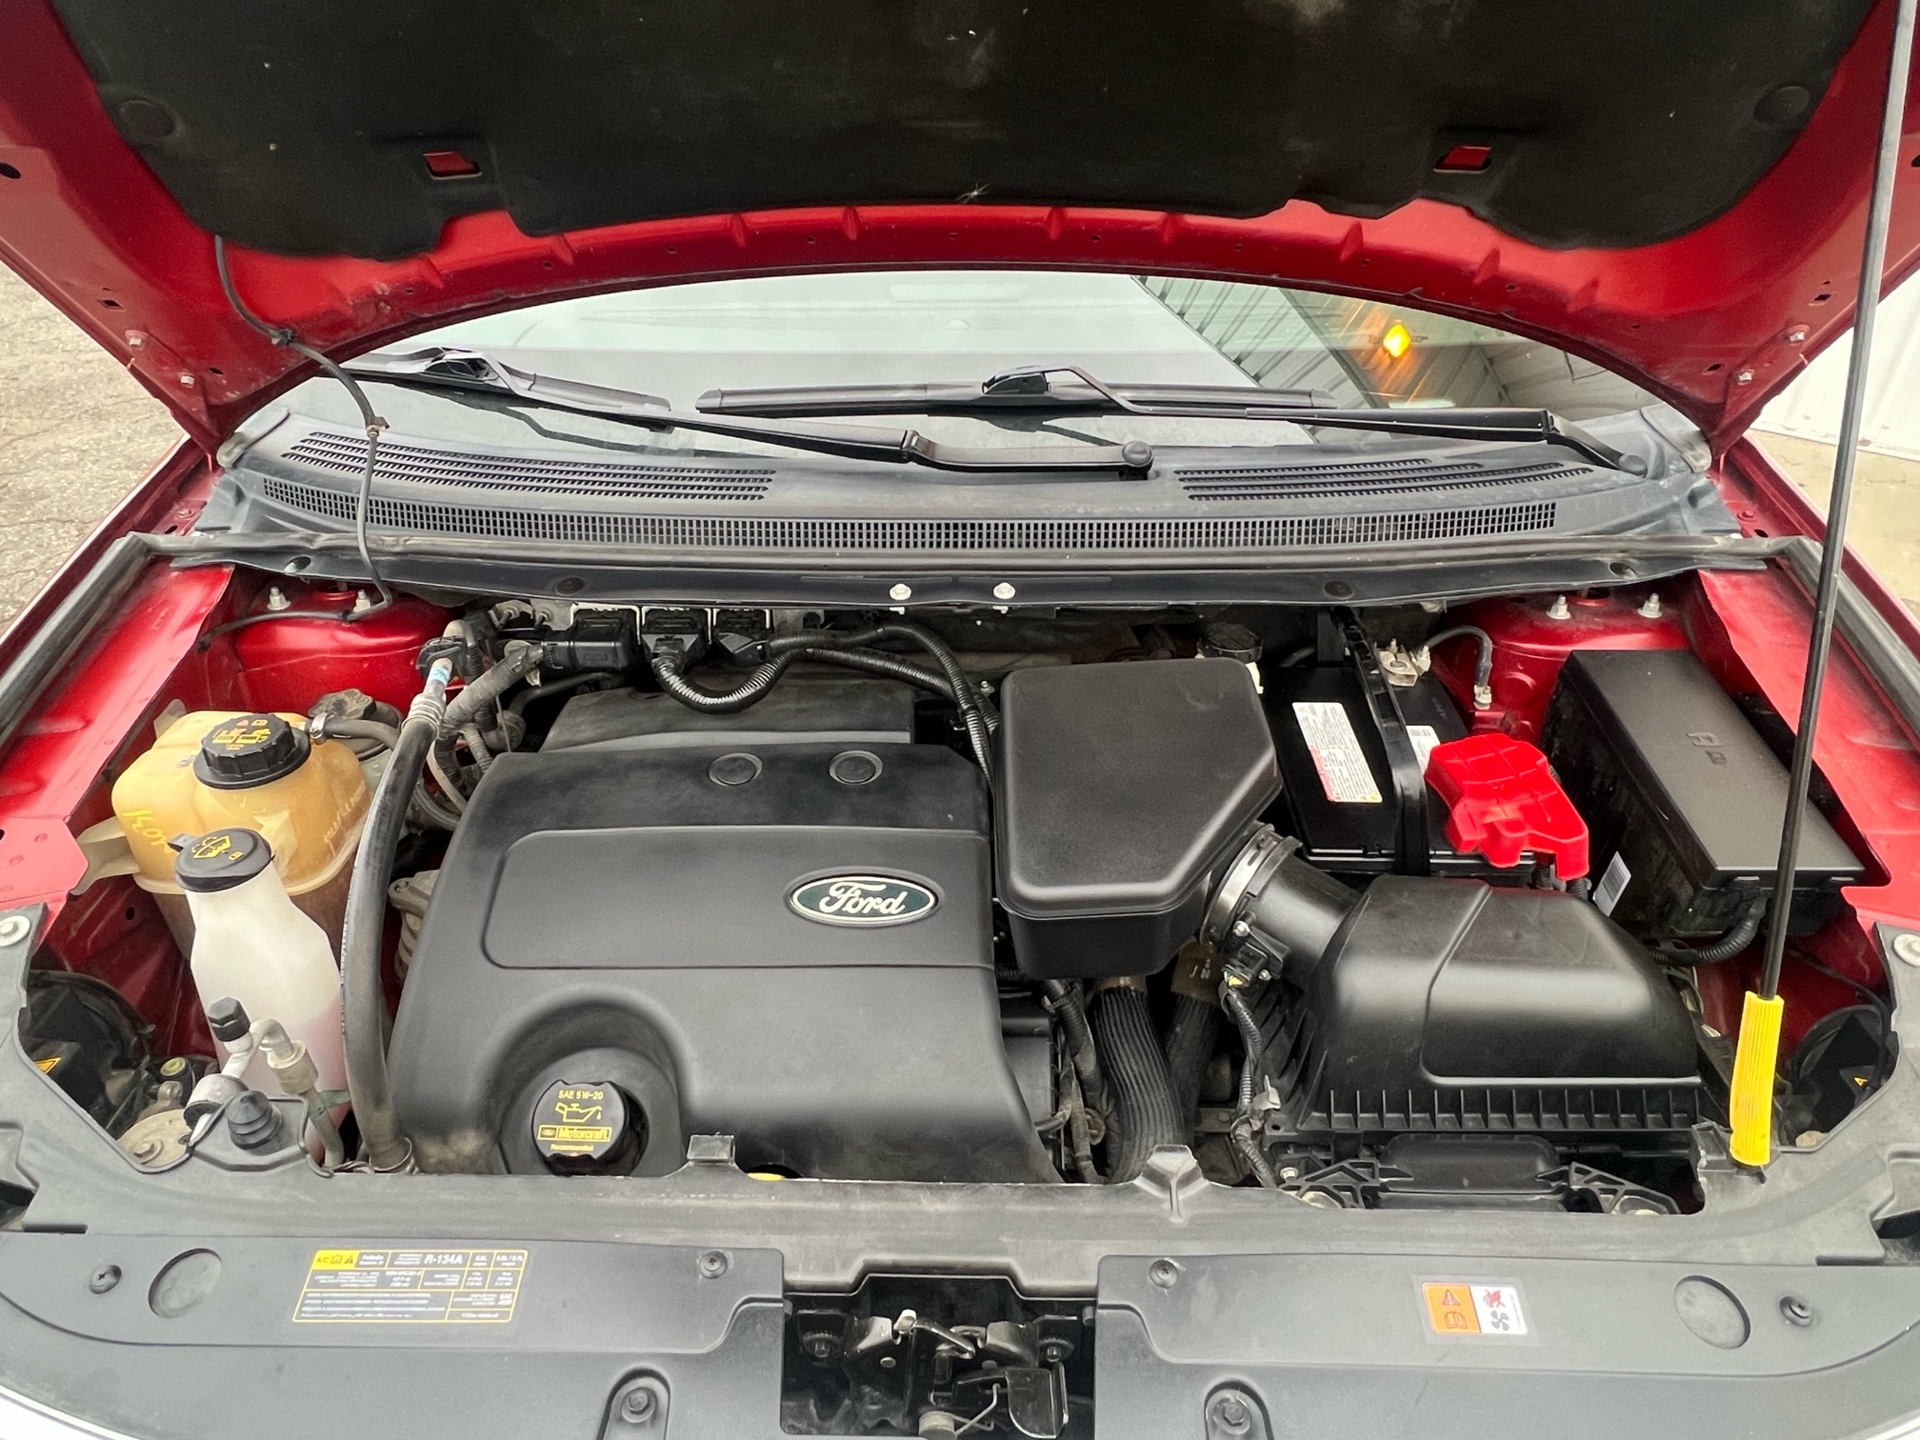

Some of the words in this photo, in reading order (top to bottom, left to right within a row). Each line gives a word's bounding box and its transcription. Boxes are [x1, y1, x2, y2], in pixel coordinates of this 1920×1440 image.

[819, 881, 908, 914] Ford
[558, 1090, 574, 1099] SAE
[576, 1090, 604, 1100] 5W-20
[558, 1127, 609, 1140] Motorcraft
[316, 1256, 330, 1265] A/C
[424, 1253, 463, 1265] R-134A
